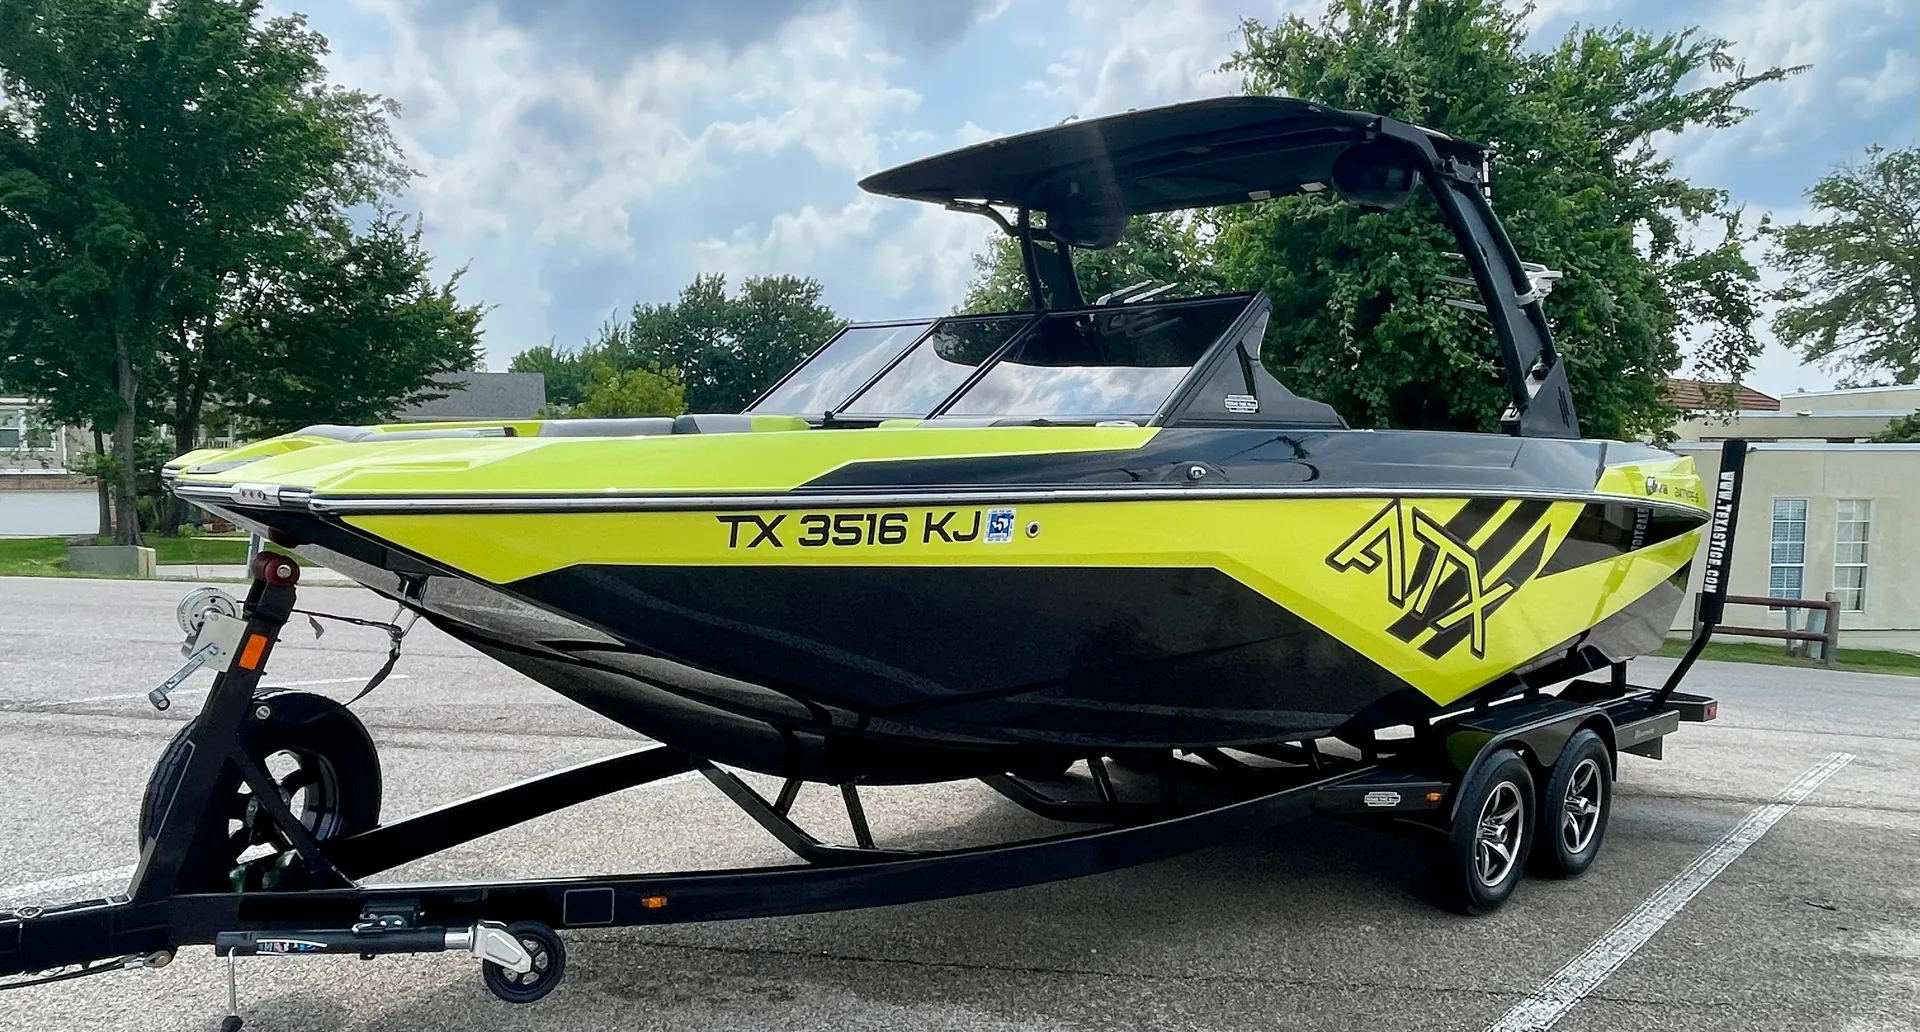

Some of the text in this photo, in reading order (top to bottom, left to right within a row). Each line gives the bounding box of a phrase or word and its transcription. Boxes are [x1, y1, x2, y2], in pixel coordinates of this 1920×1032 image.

[716, 511, 982, 548] TX 3516 KJ
[1325, 500, 1518, 660] ATX
